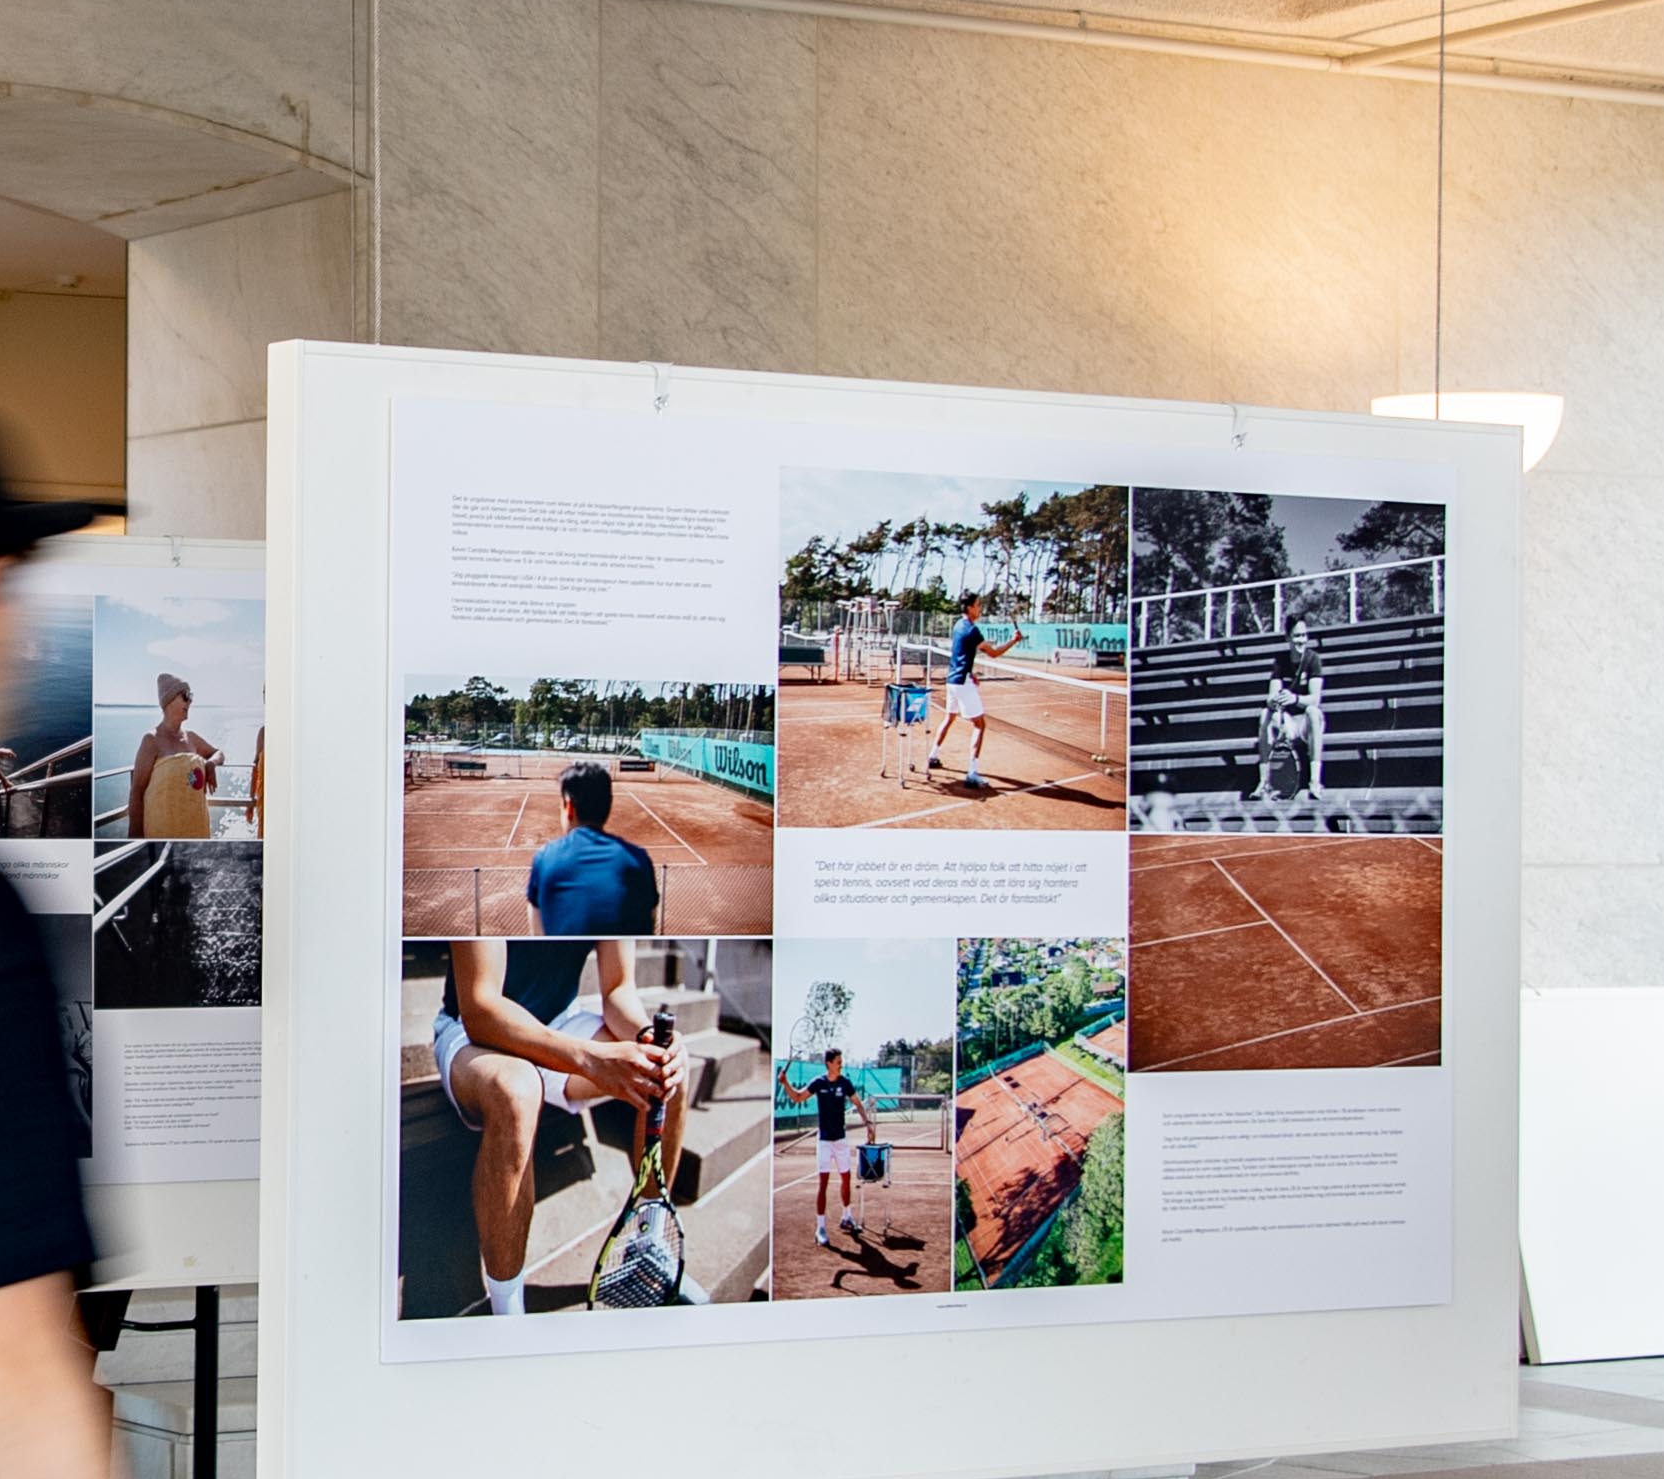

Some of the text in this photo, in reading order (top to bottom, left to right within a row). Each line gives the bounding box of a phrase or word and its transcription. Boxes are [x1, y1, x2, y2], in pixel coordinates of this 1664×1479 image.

[714, 745, 768, 787] Wilson
[854, 861, 886, 873] jobbet
[901, 863, 912, 871] en
[944, 861, 957, 871] Att
[990, 862, 1006, 872] folk
[1008, 863, 1021, 872] att
[1023, 862, 1043, 872] hitta
[1075, 863, 1087, 872] att
[814, 878, 840, 889] spela
[875, 878, 911, 888] oavsett
[913, 878, 930, 888] vad
[932, 878, 958, 888] deras
[993, 879, 1006, 888] att
[1028, 879, 1040, 890] sig
[814, 894, 837, 904] olika
[839, 894, 889, 904] situationer
[891, 894, 908, 904] och
[980, 894, 997, 904] Det
